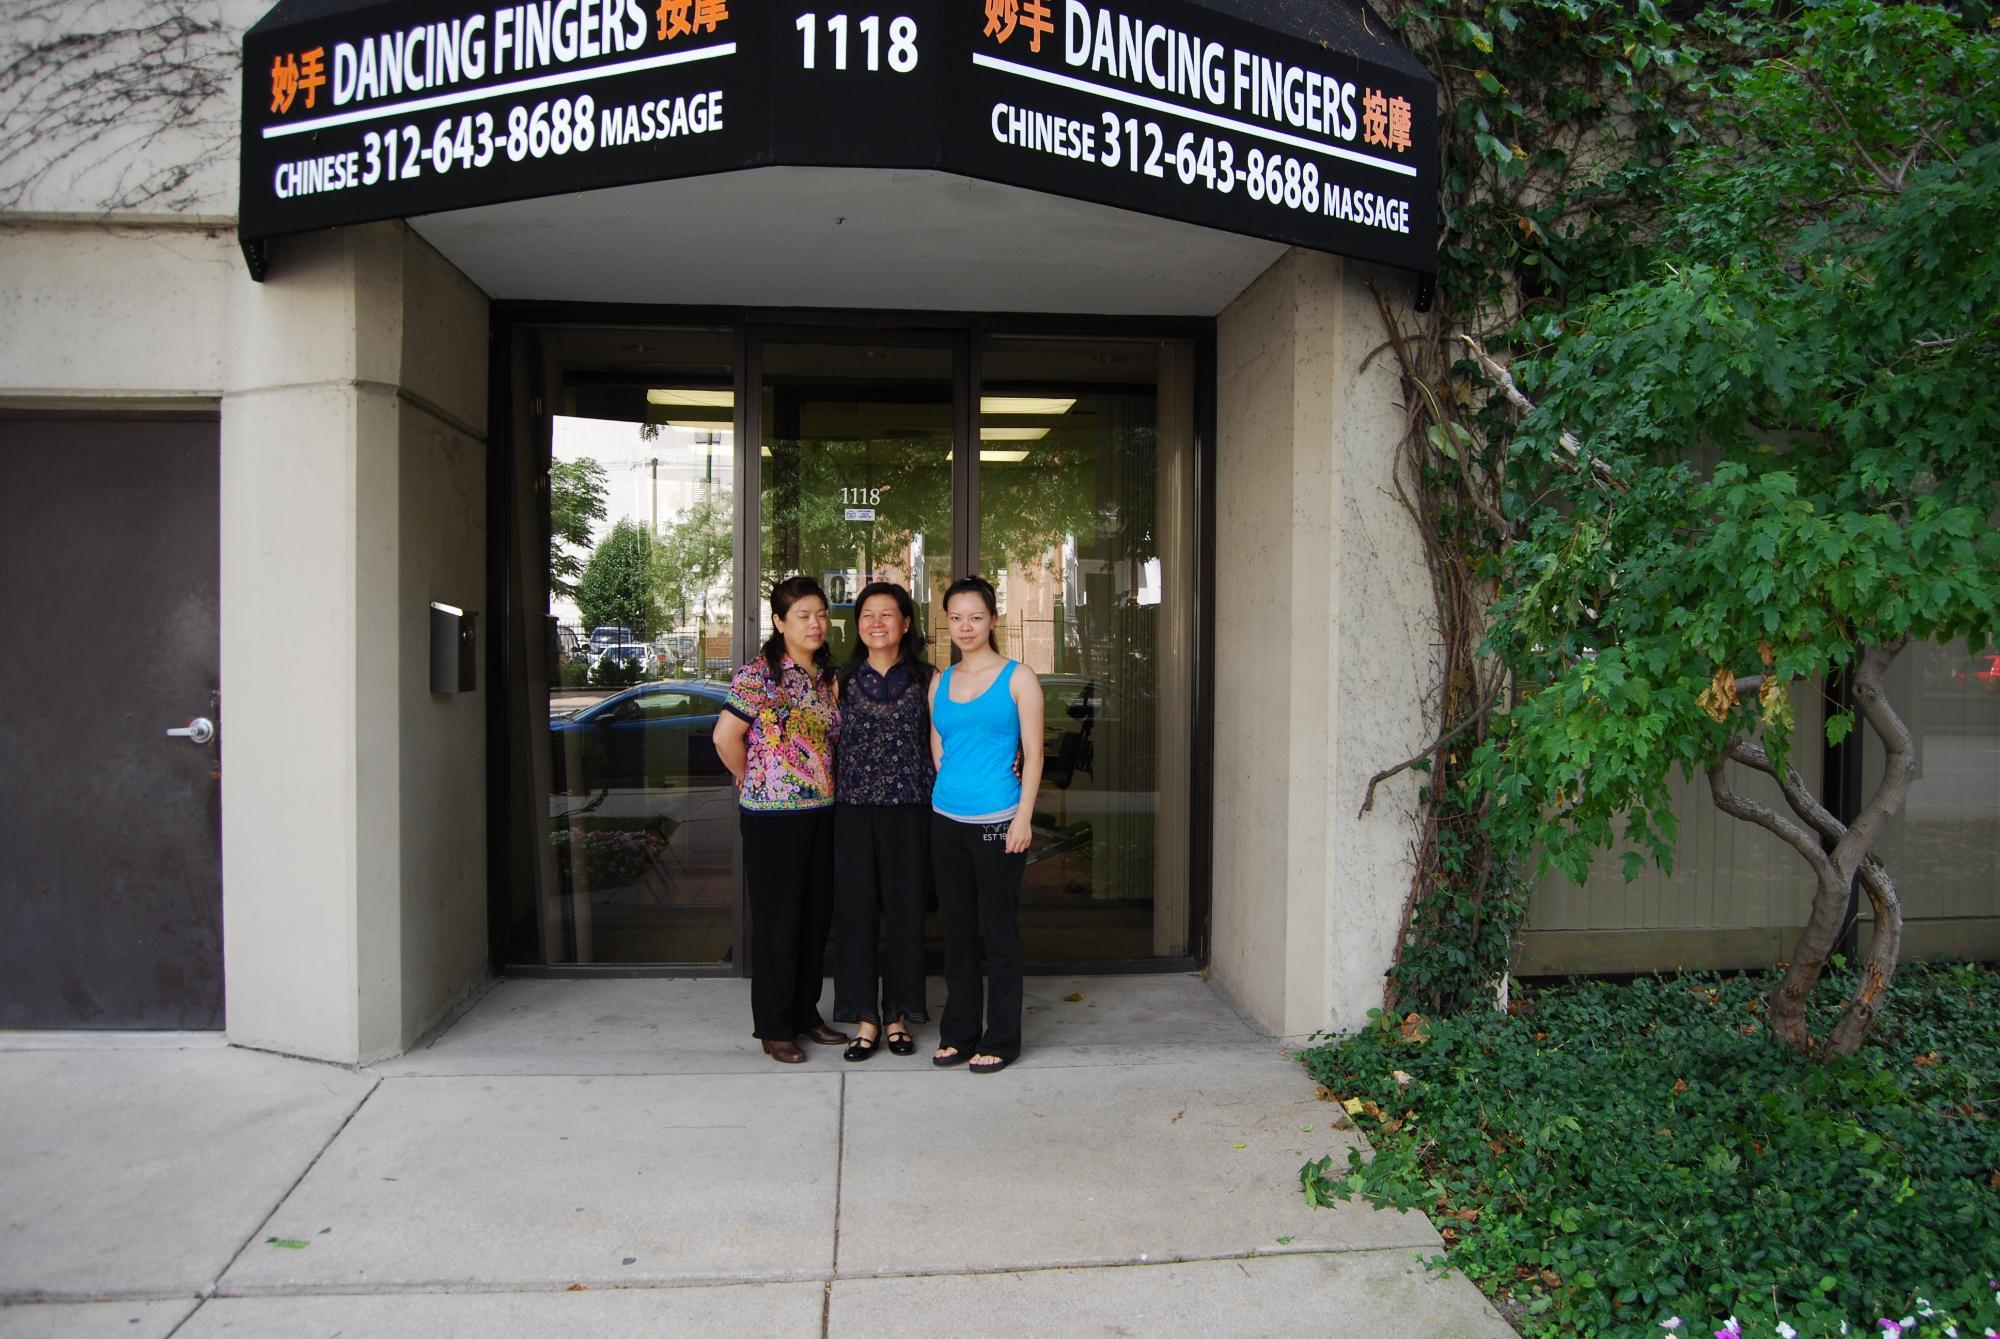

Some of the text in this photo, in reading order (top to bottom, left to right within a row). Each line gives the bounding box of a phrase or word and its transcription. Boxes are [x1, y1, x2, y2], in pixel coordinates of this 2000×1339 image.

[333, 0, 648, 106] DANCING FINGERS
[795, 12, 919, 73] 1118
[1065, 0, 1357, 142] DANCING FINGERS
[271, 47, 326, 114] 妙手
[275, 90, 723, 199] CHINESE 312-643-8688 MASSAGE
[1362, 87, 1412, 153] 按摩
[991, 102, 1410, 234] CHINESE 312-643-8688 MASSAGE
[840, 487, 881, 506] 1118
[983, 833, 997, 841] EST
